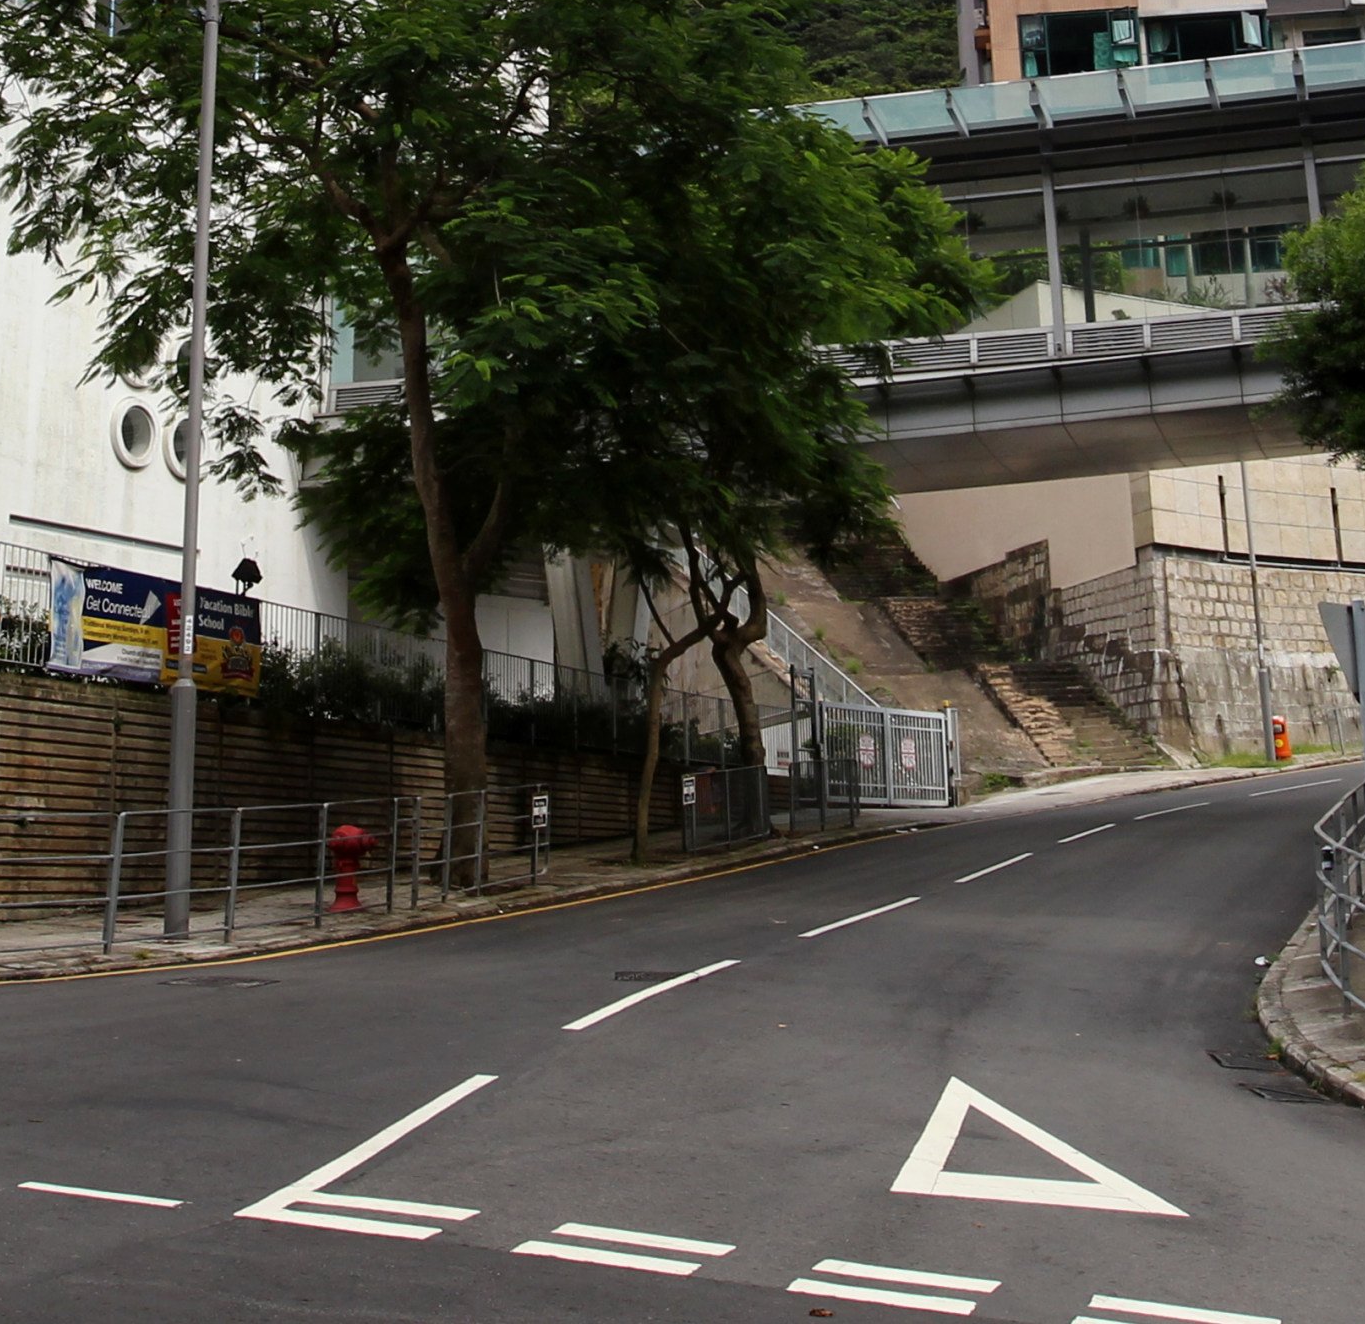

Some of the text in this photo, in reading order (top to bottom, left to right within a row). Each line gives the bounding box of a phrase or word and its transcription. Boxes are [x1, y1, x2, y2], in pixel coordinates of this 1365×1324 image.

[85, 578, 123, 594] WELCOME
[86, 595, 101, 612] Get
[198, 614, 225, 630] School
